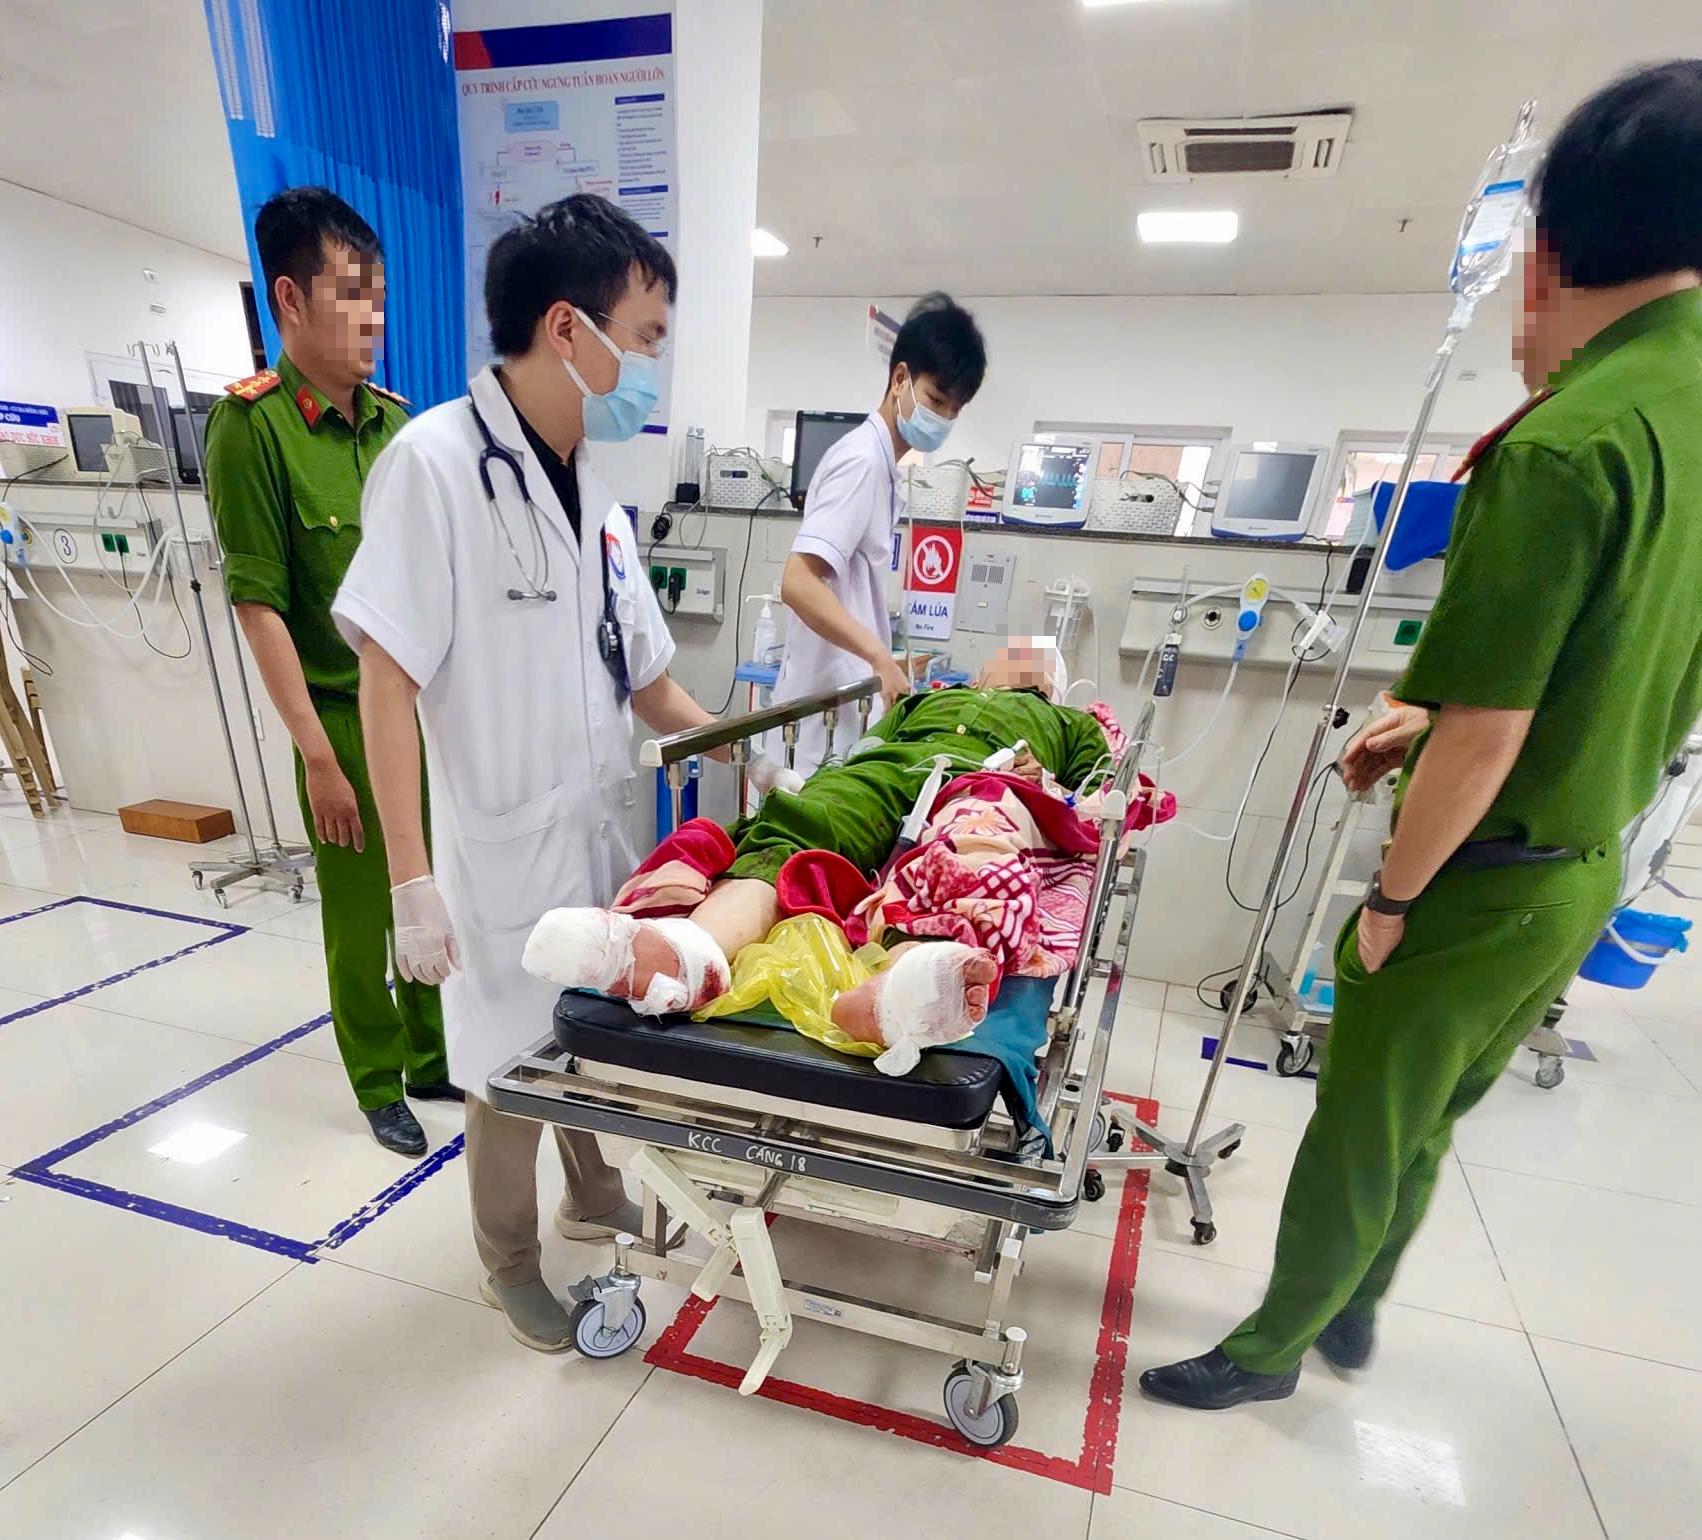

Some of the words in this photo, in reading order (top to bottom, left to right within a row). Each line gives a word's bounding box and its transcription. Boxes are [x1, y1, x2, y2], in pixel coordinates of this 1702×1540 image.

[462, 82, 478, 96] QUY
[61, 535, 71, 556] 3
[688, 1131, 722, 1153] KCC
[790, 1154, 807, 1172] 18
